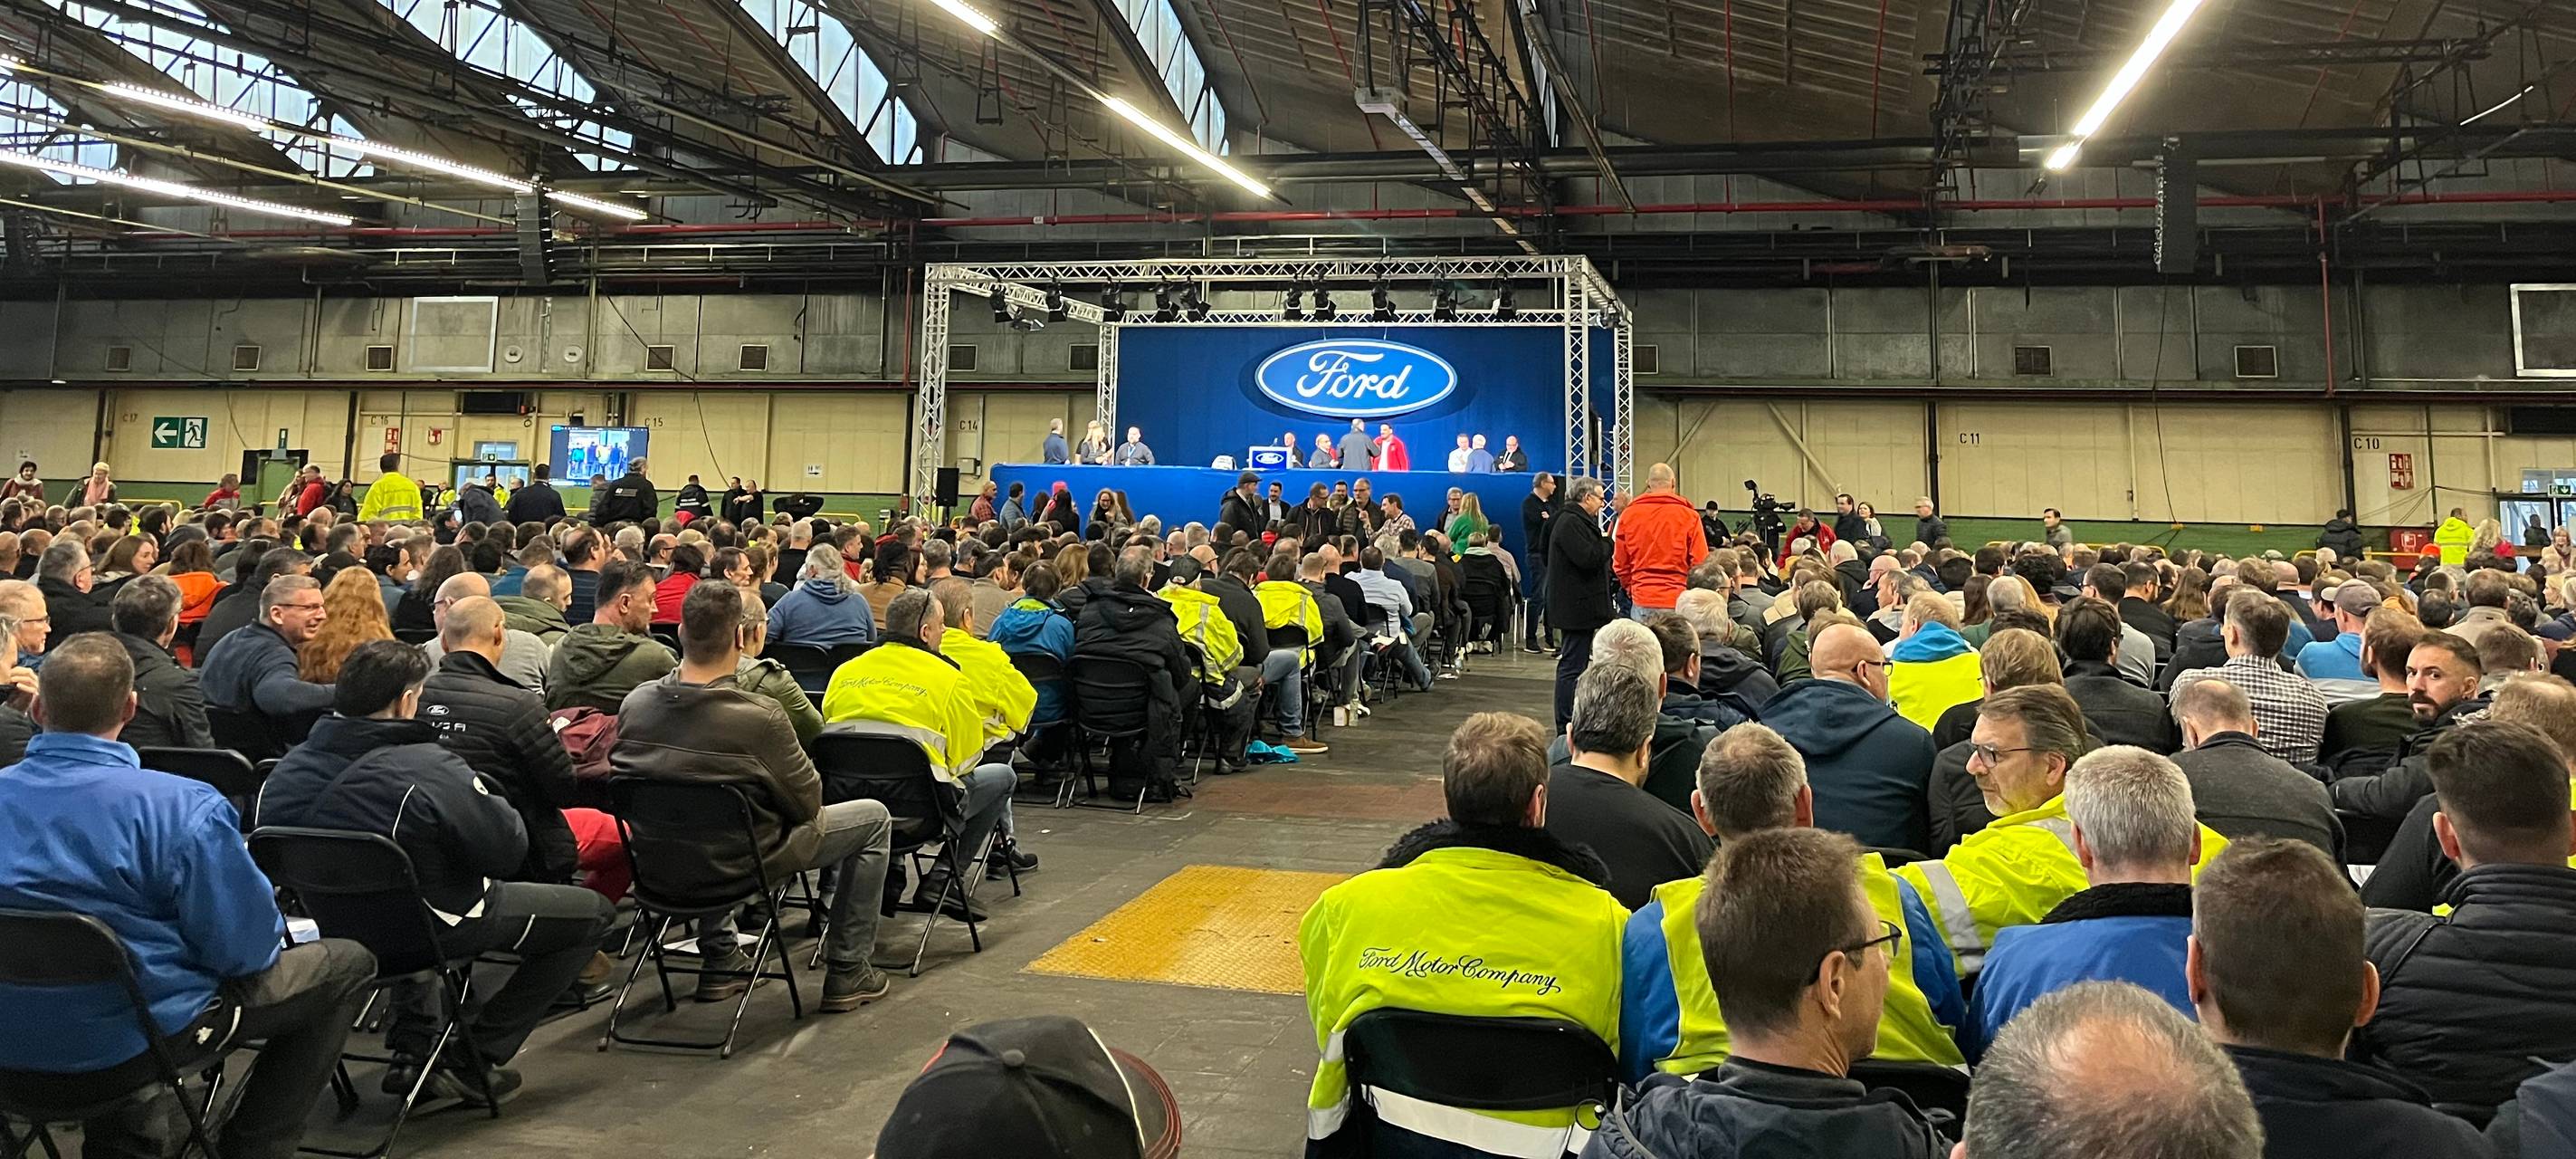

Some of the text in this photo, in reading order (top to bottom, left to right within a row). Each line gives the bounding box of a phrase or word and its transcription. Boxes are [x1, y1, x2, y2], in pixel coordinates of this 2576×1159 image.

[1296, 350, 1412, 398] Ford
[380, 415, 388, 426] 16
[653, 417, 663, 426] 15
[968, 419, 978, 430] 14
[1960, 433, 1980, 445] C 11
[2353, 437, 2380, 450] C 10
[1359, 947, 1561, 995] Ford Motor Company
